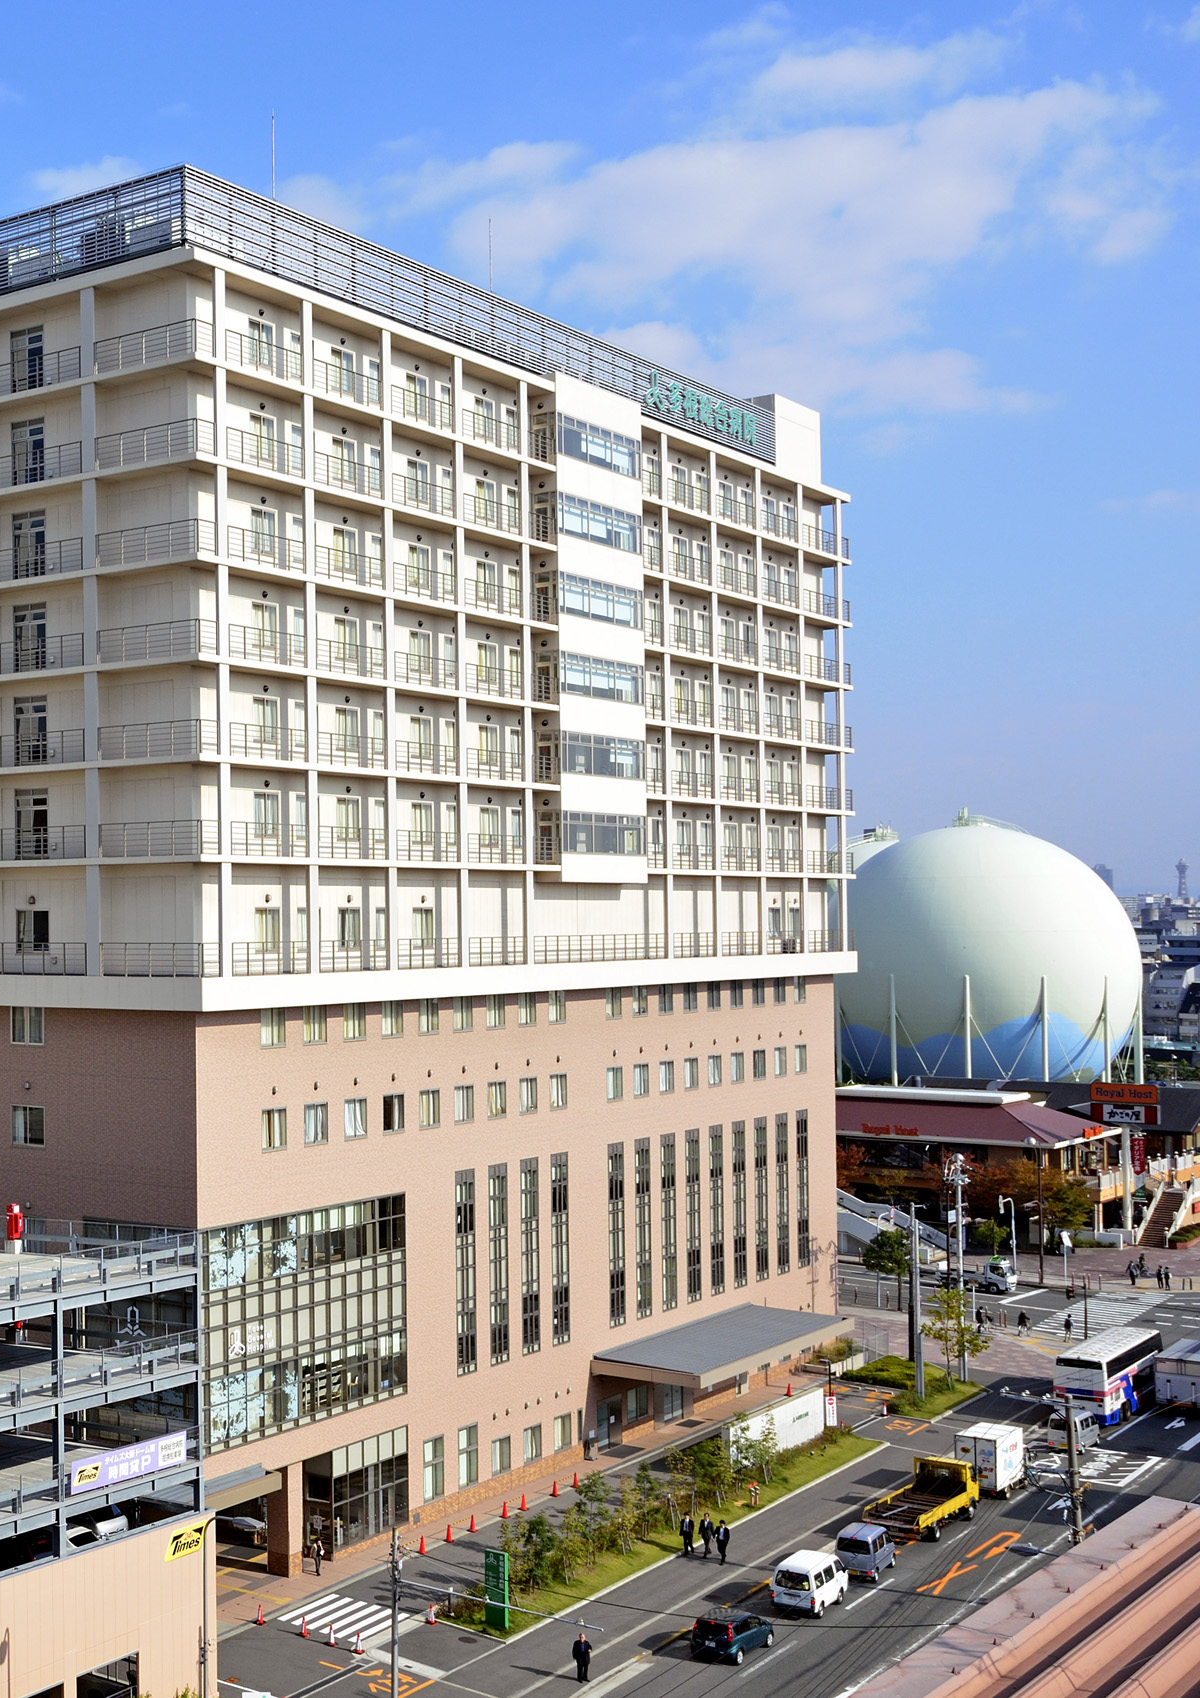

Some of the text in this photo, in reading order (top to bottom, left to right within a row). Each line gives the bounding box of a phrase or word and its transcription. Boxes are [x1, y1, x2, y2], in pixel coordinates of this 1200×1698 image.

[667, 381, 757, 445] 多根総合病院
[1095, 1087, 1153, 1099] Royal Host
[1107, 1109, 1141, 1121] かごの屋
[861, 1122, 920, 1136] Royal Host
[108, 1455, 152, 1480] 時間貸P
[77, 1471, 98, 1483] Times
[171, 1537, 200, 1556] Times
